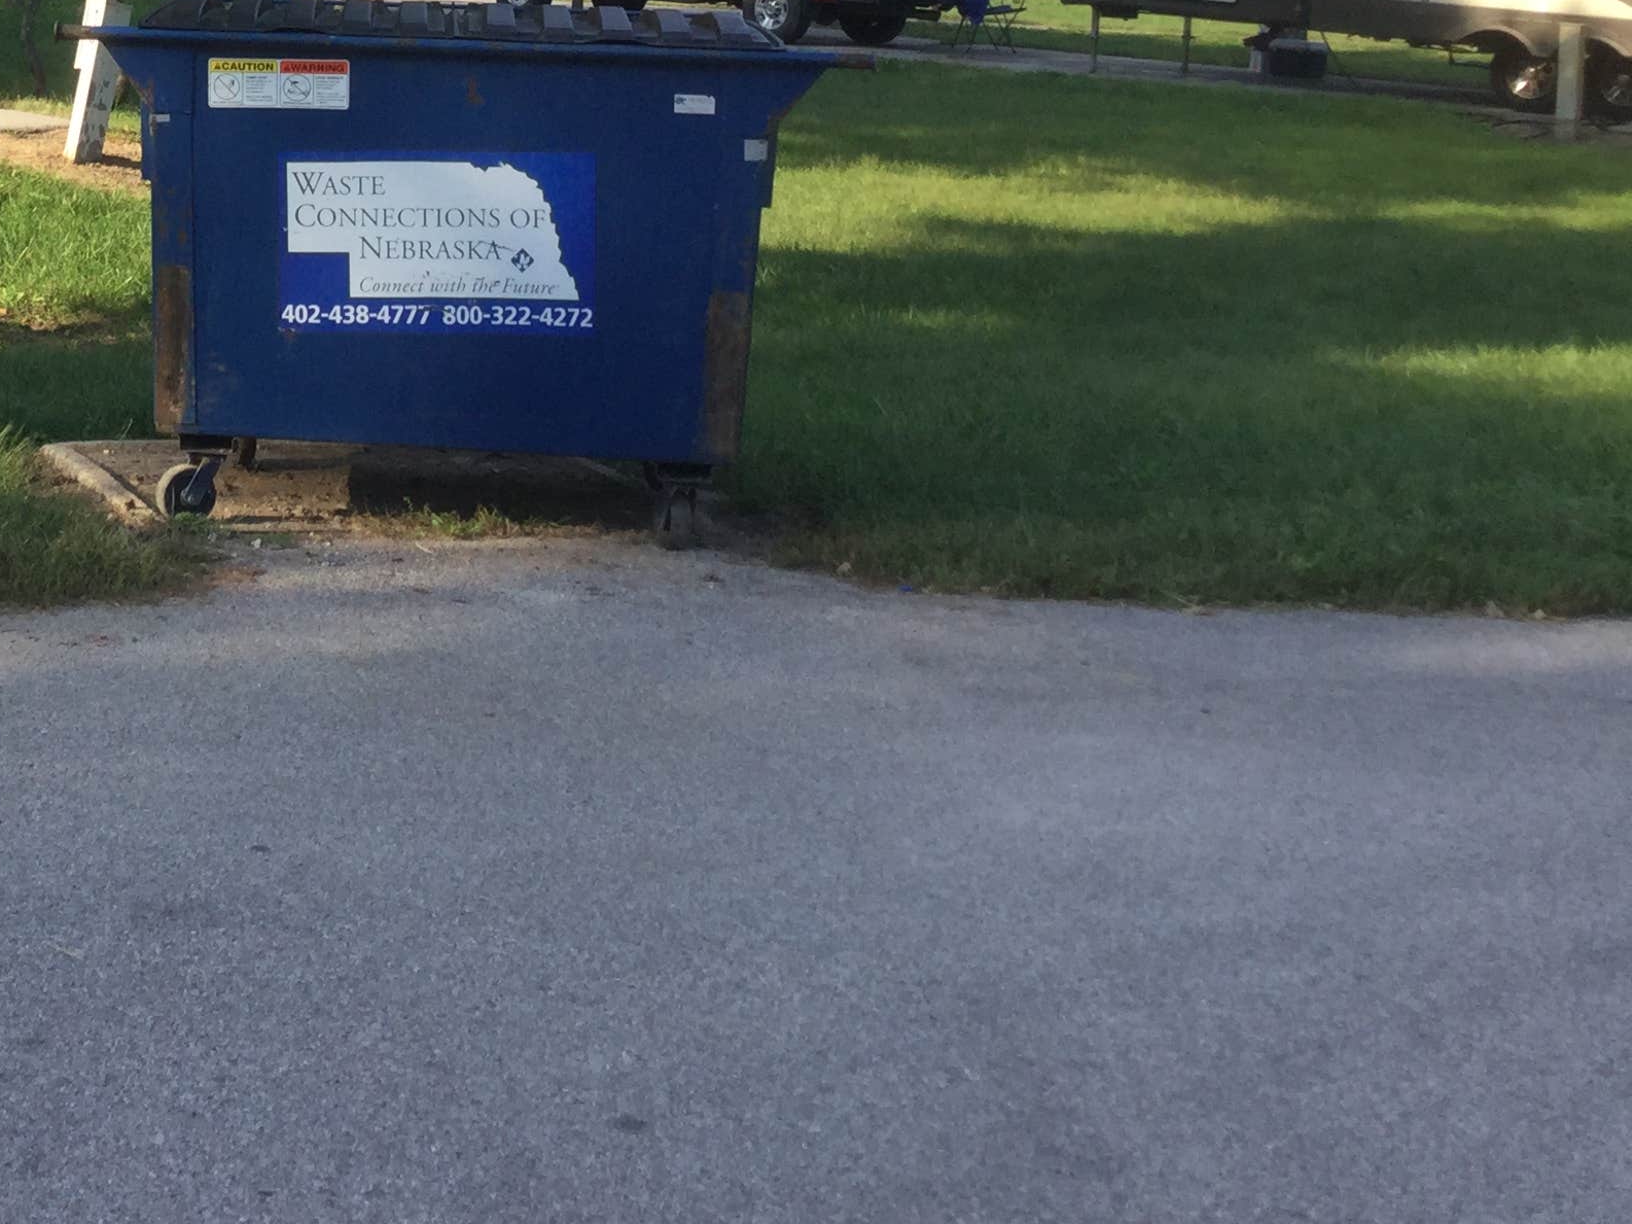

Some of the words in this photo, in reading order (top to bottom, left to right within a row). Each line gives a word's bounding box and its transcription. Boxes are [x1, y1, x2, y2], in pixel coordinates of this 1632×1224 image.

[221, 62, 274, 71] CAUTION
[290, 63, 345, 73] WARNING
[292, 171, 386, 196] WASTE
[294, 203, 501, 228] CONNECTIONS
[510, 207, 547, 229] OF
[359, 235, 502, 261] NEBRASKA
[359, 276, 424, 293] Connect
[430, 276, 466, 293] with
[472, 276, 498, 294] the
[502, 277, 557, 295] Future
[281, 303, 431, 325] 402-438-4777
[442, 305, 593, 327] 800-322-4272
